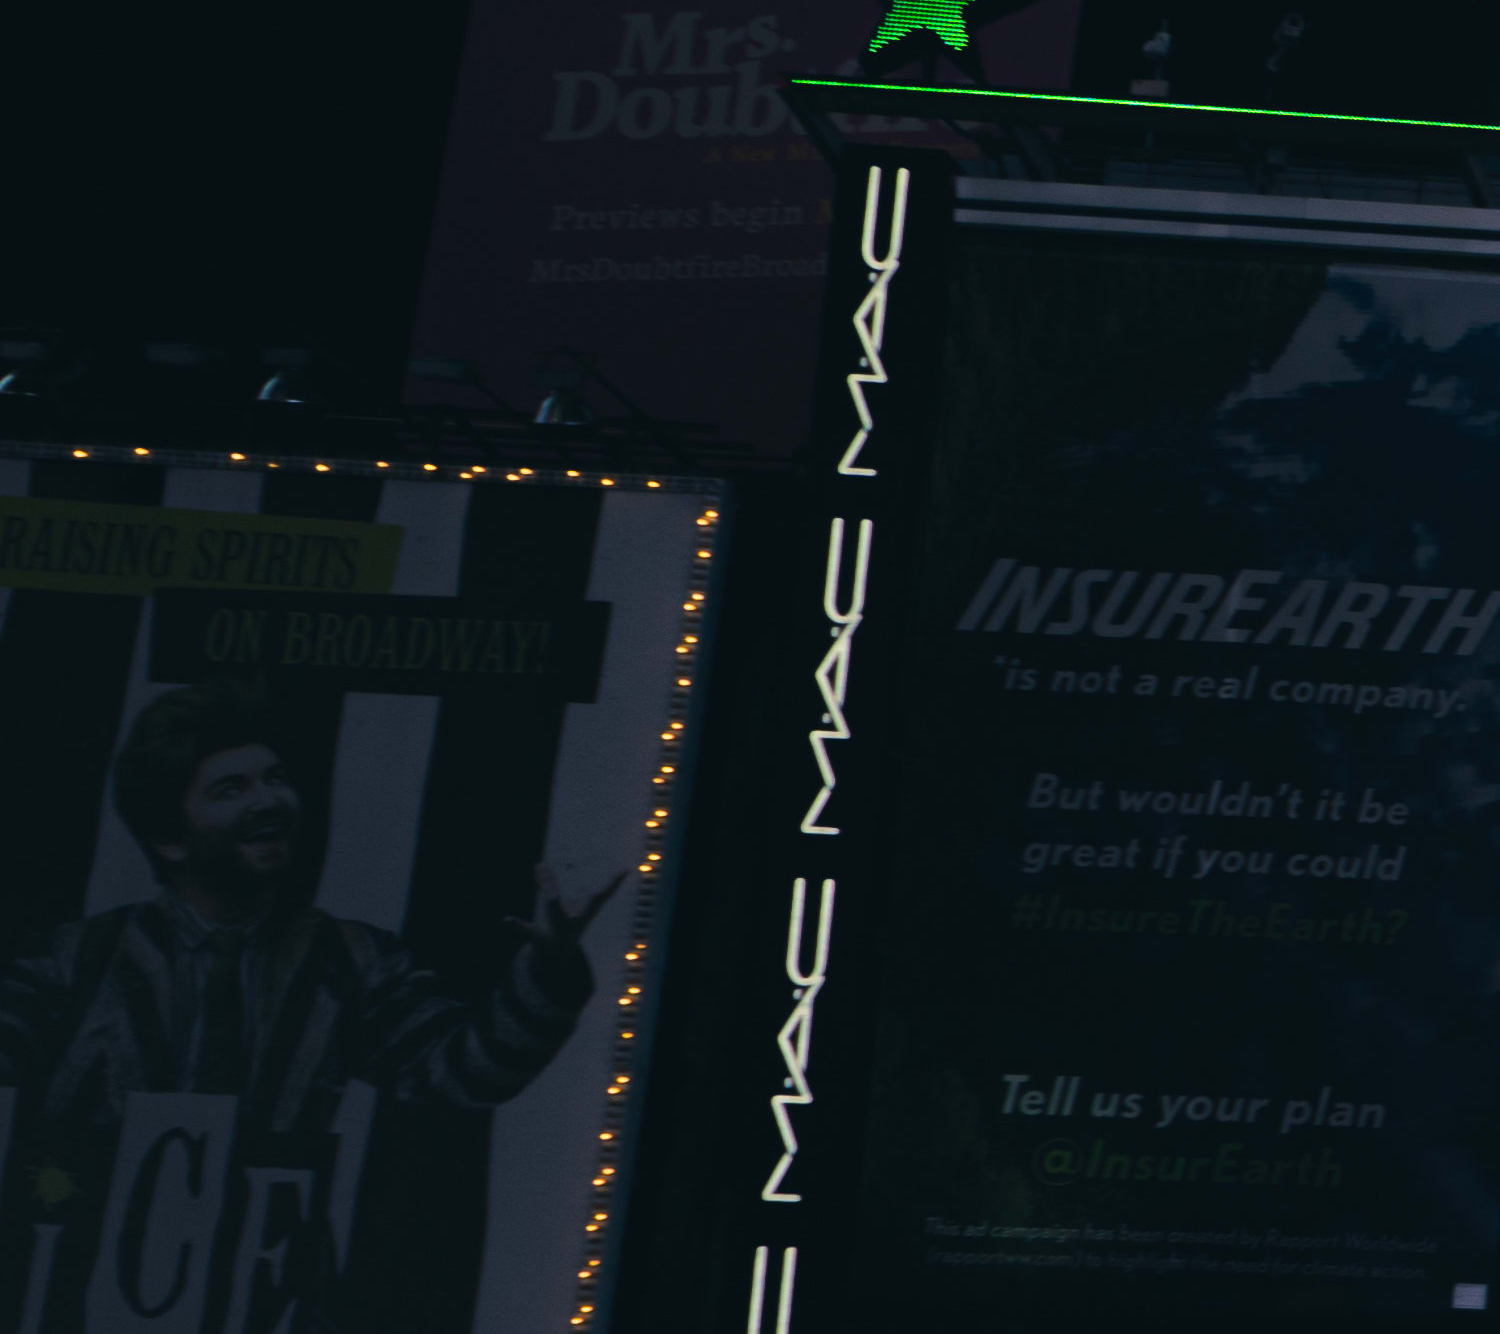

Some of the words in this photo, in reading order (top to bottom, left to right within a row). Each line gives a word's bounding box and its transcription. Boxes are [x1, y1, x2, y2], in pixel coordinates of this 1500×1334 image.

[544, 61, 808, 141] Doub
[1, 515, 176, 579] RAISING
[197, 528, 360, 590] SPIRITS
[205, 608, 265, 662] ON
[281, 611, 552, 675] BROADWAY!
[1050, 663, 1122, 696] not
[1171, 665, 1261, 701] real
[1026, 772, 1103, 811] But
[1315, 787, 1345, 823] it
[1357, 789, 1409, 826] be
[1020, 837, 1142, 874] great
[1153, 834, 1186, 877] if
[1195, 847, 1271, 879] you
[1286, 844, 1407, 881] could
[1000, 1073, 1081, 1116] Tell
[1090, 1087, 1143, 1119] us
[1155, 1091, 1269, 1128] your
[1280, 1087, 1386, 1132] plan
